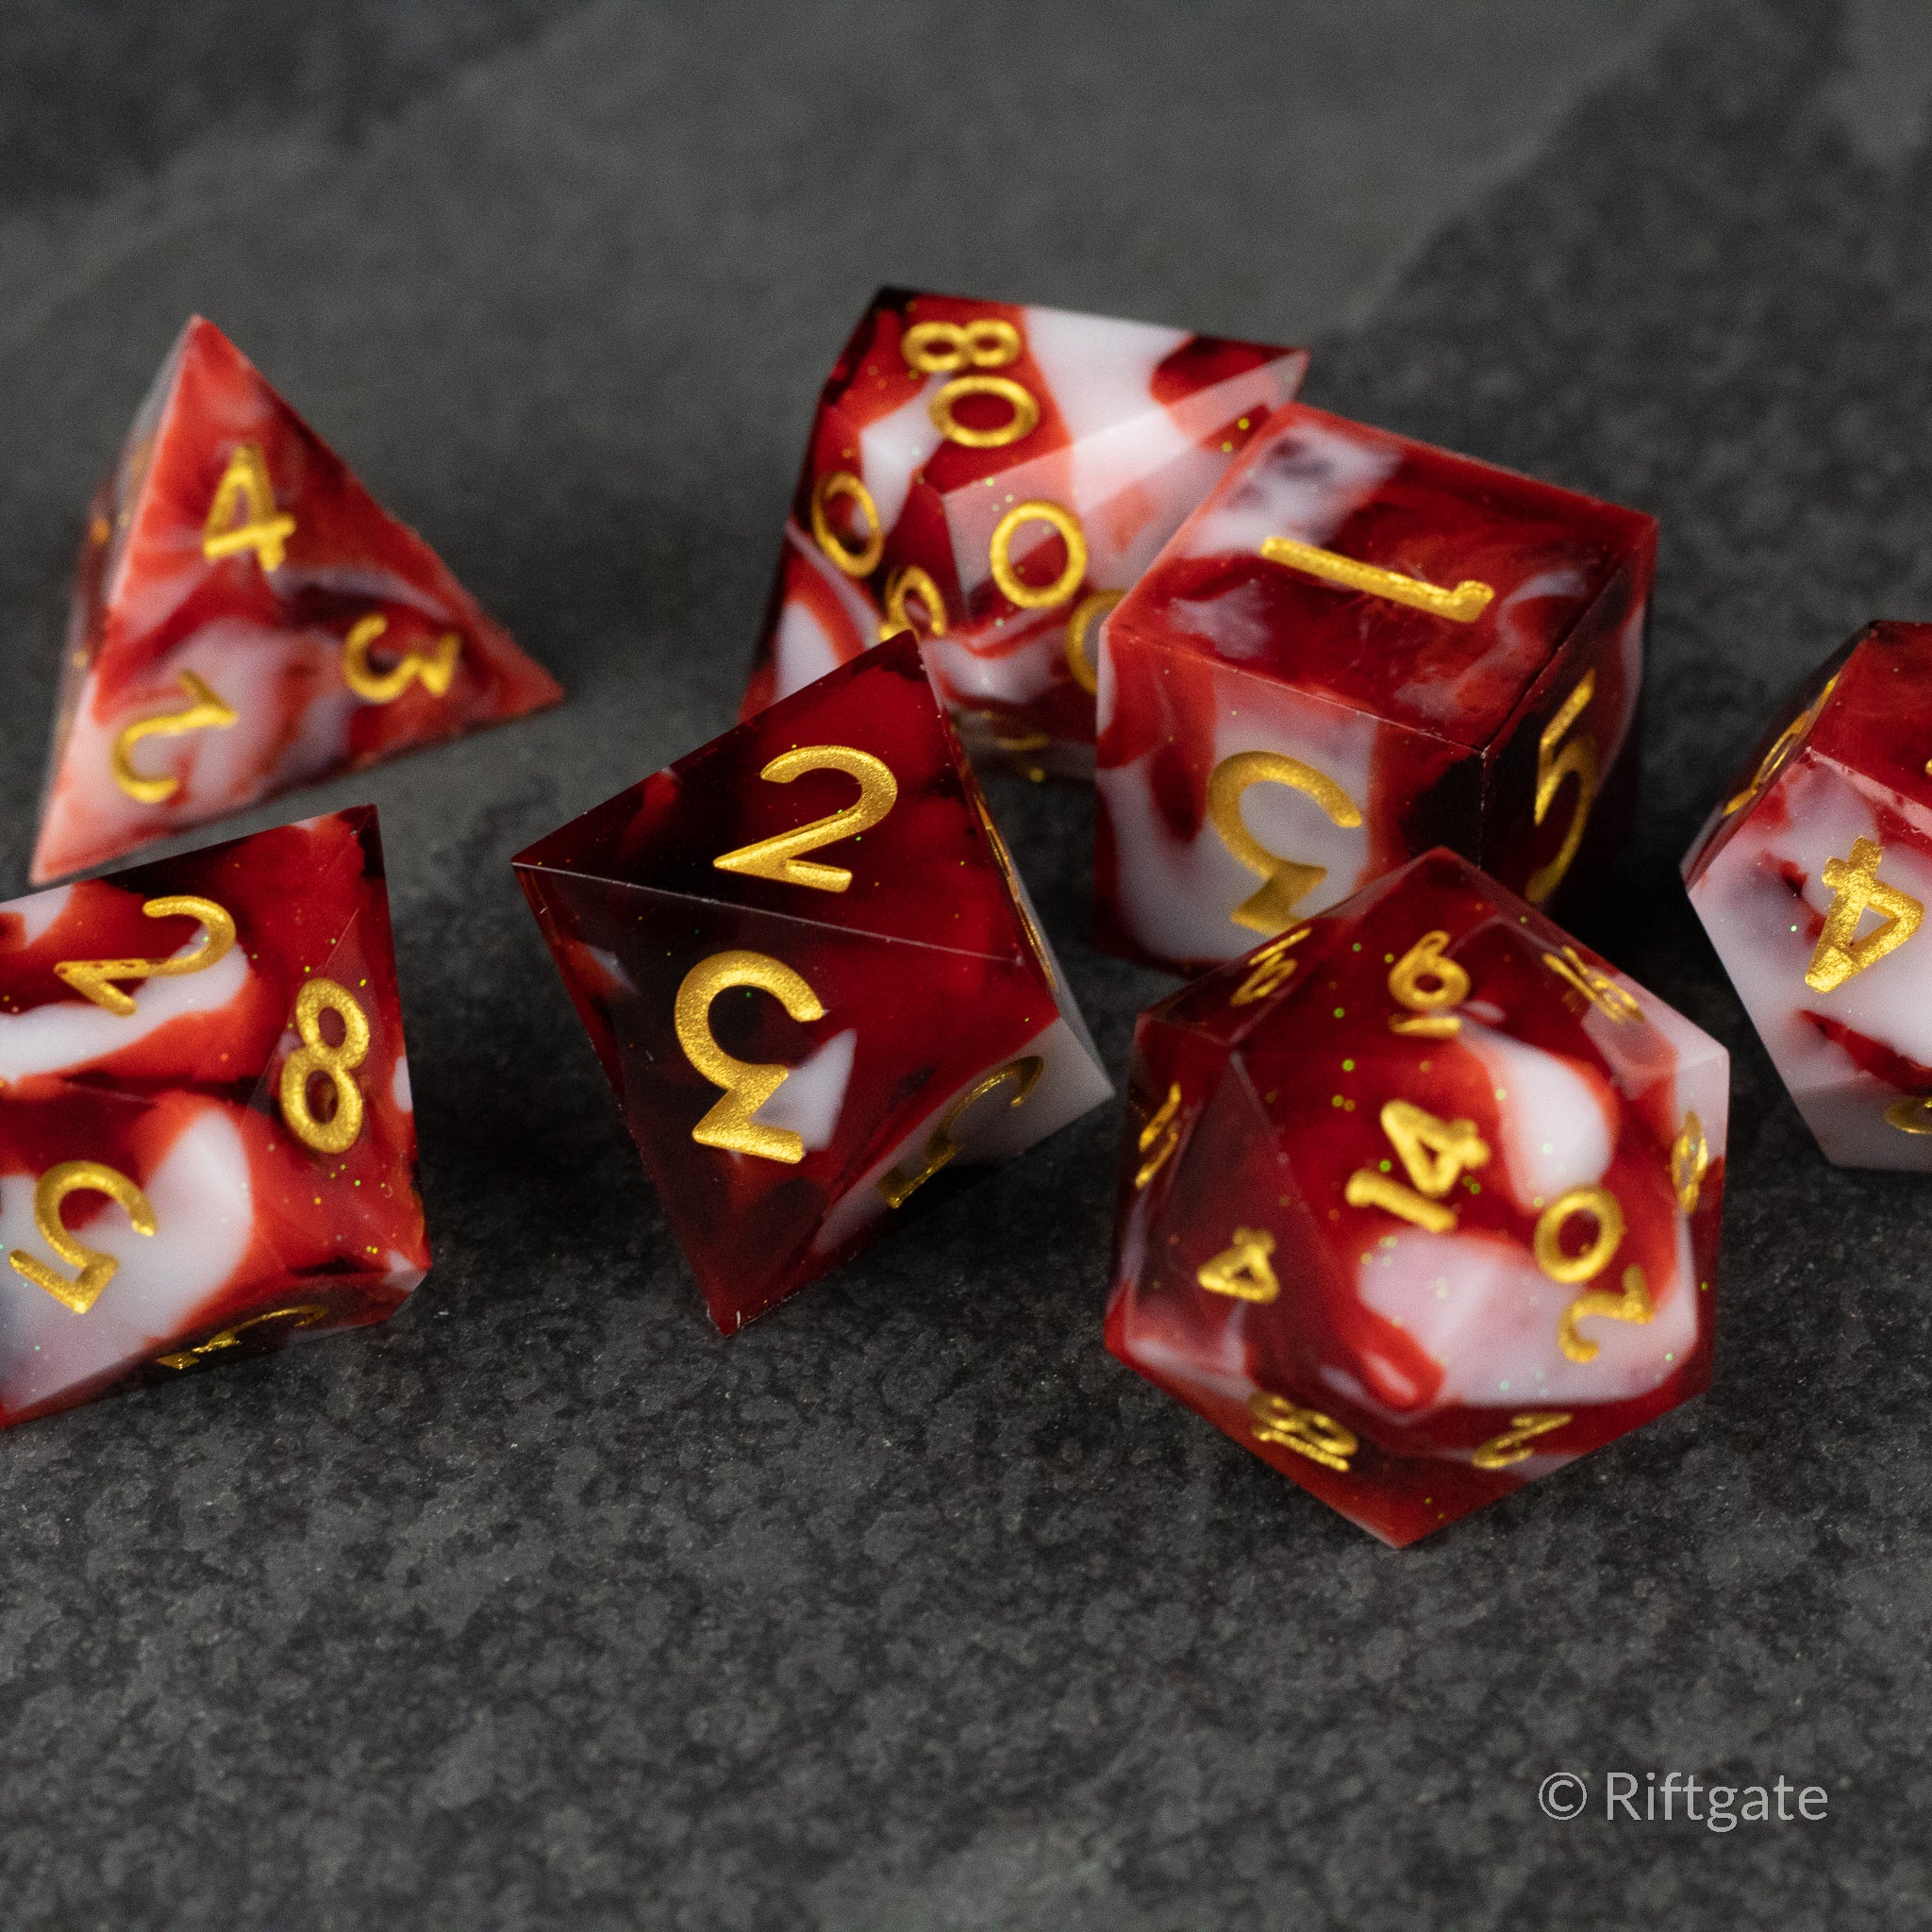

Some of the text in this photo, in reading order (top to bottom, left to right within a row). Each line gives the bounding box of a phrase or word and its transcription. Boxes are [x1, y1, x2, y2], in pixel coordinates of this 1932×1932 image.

[901, 319, 1039, 448] 80
[205, 442, 296, 573] 4
[1260, 536, 1495, 624] 1
[343, 613, 461, 704] 3
[110, 669, 239, 804] 2
[712, 744, 898, 893] 2
[54, 895, 237, 1017] 2
[1804, 836, 1924, 994] 4
[281, 977, 371, 1155] 8
[673, 949, 824, 1165] 3
[1345, 1099, 1491, 1235] 14
[8, 1160, 159, 1314] 5
[1198, 1226, 1281, 1305] 4
[1534, 1184, 1657, 1363] 20
